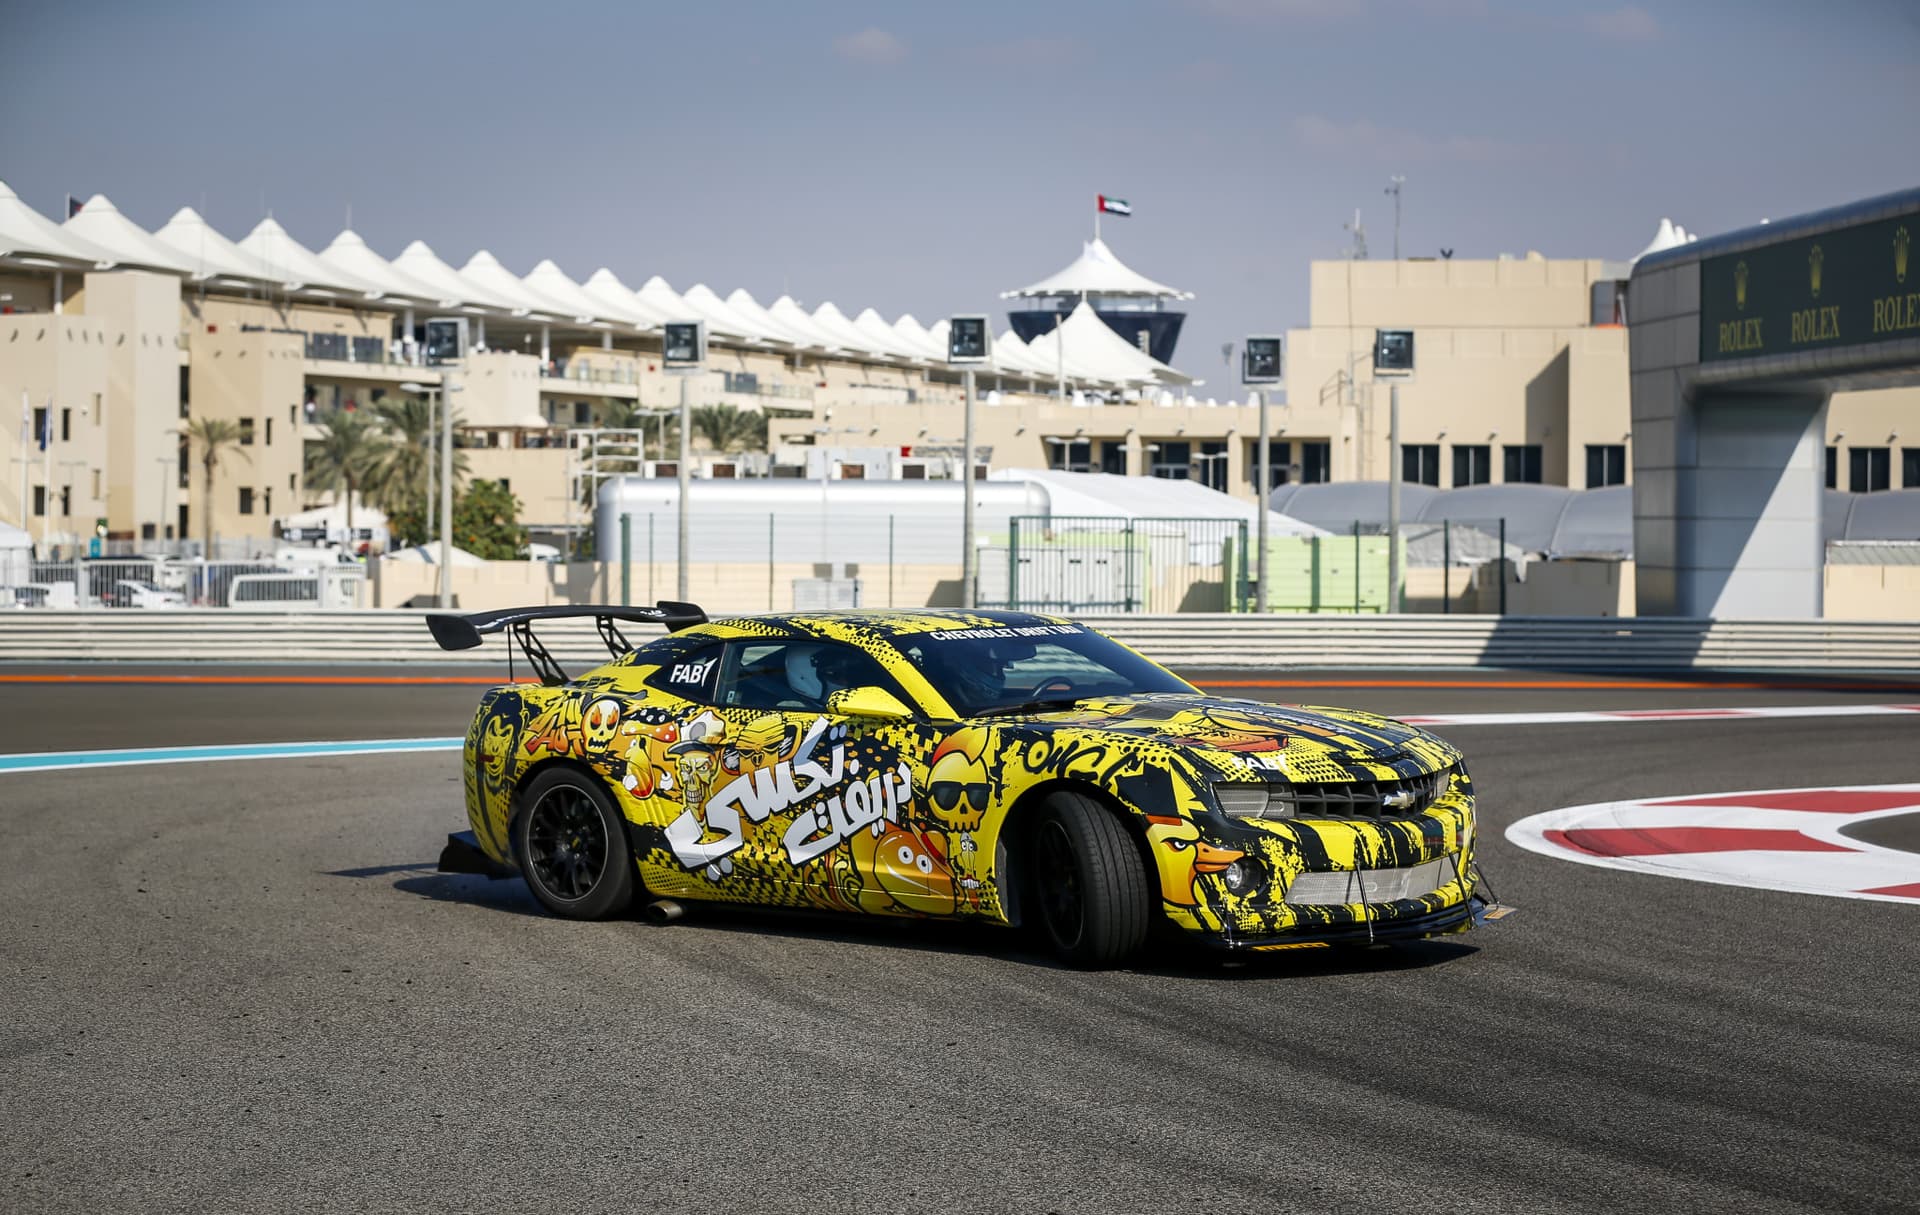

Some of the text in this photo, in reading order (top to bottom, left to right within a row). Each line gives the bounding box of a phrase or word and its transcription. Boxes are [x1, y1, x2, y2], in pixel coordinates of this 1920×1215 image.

[1791, 305, 1840, 343] ROLEX
[1873, 294, 1920, 333] ROLE
[1719, 317, 1763, 352] ROLEX
[929, 627, 1018, 641] CHEVROLET
[1013, 626, 1057, 637] DRIFT
